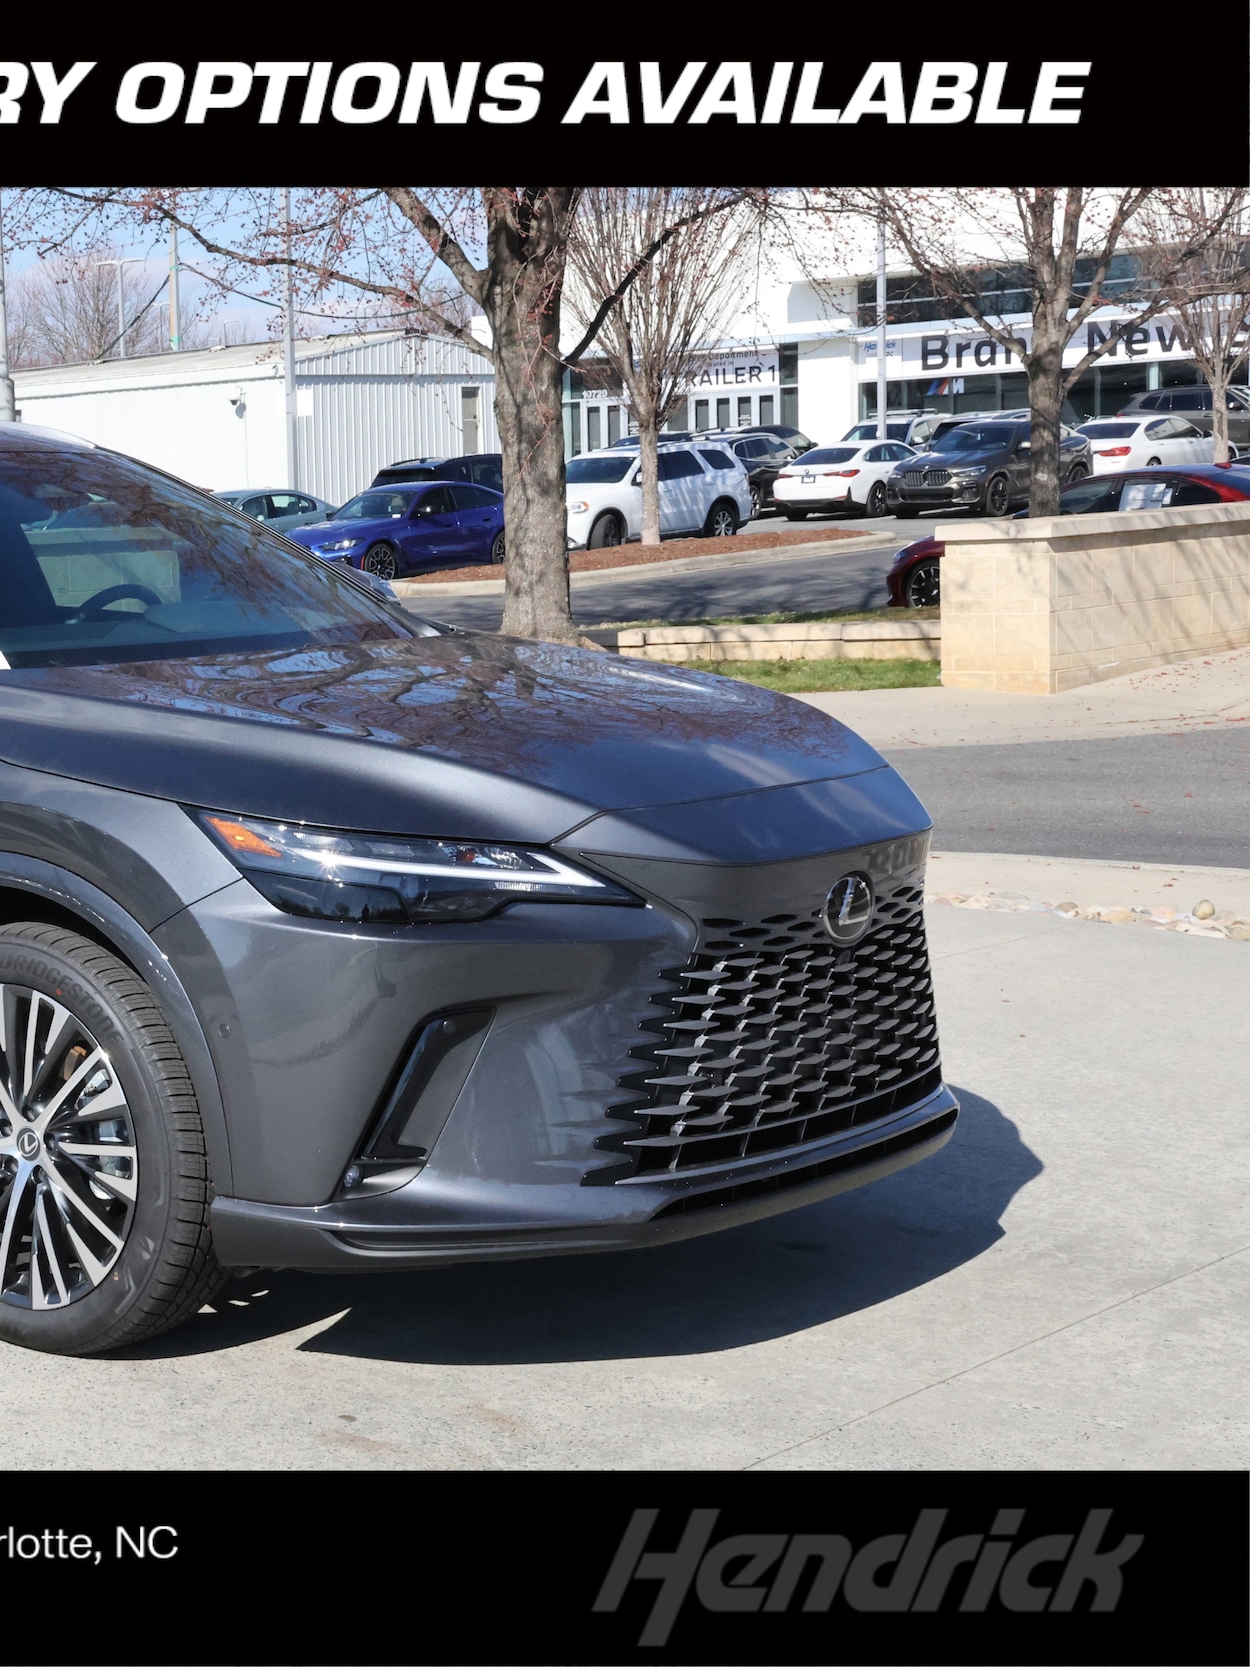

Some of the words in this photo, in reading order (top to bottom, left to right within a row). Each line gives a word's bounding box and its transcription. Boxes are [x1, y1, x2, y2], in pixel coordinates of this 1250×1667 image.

[921, 333, 1029, 372] Bran
[1086, 319, 1195, 357] New
[768, 365, 776, 382] 1
[582, 388, 608, 399] 10720
